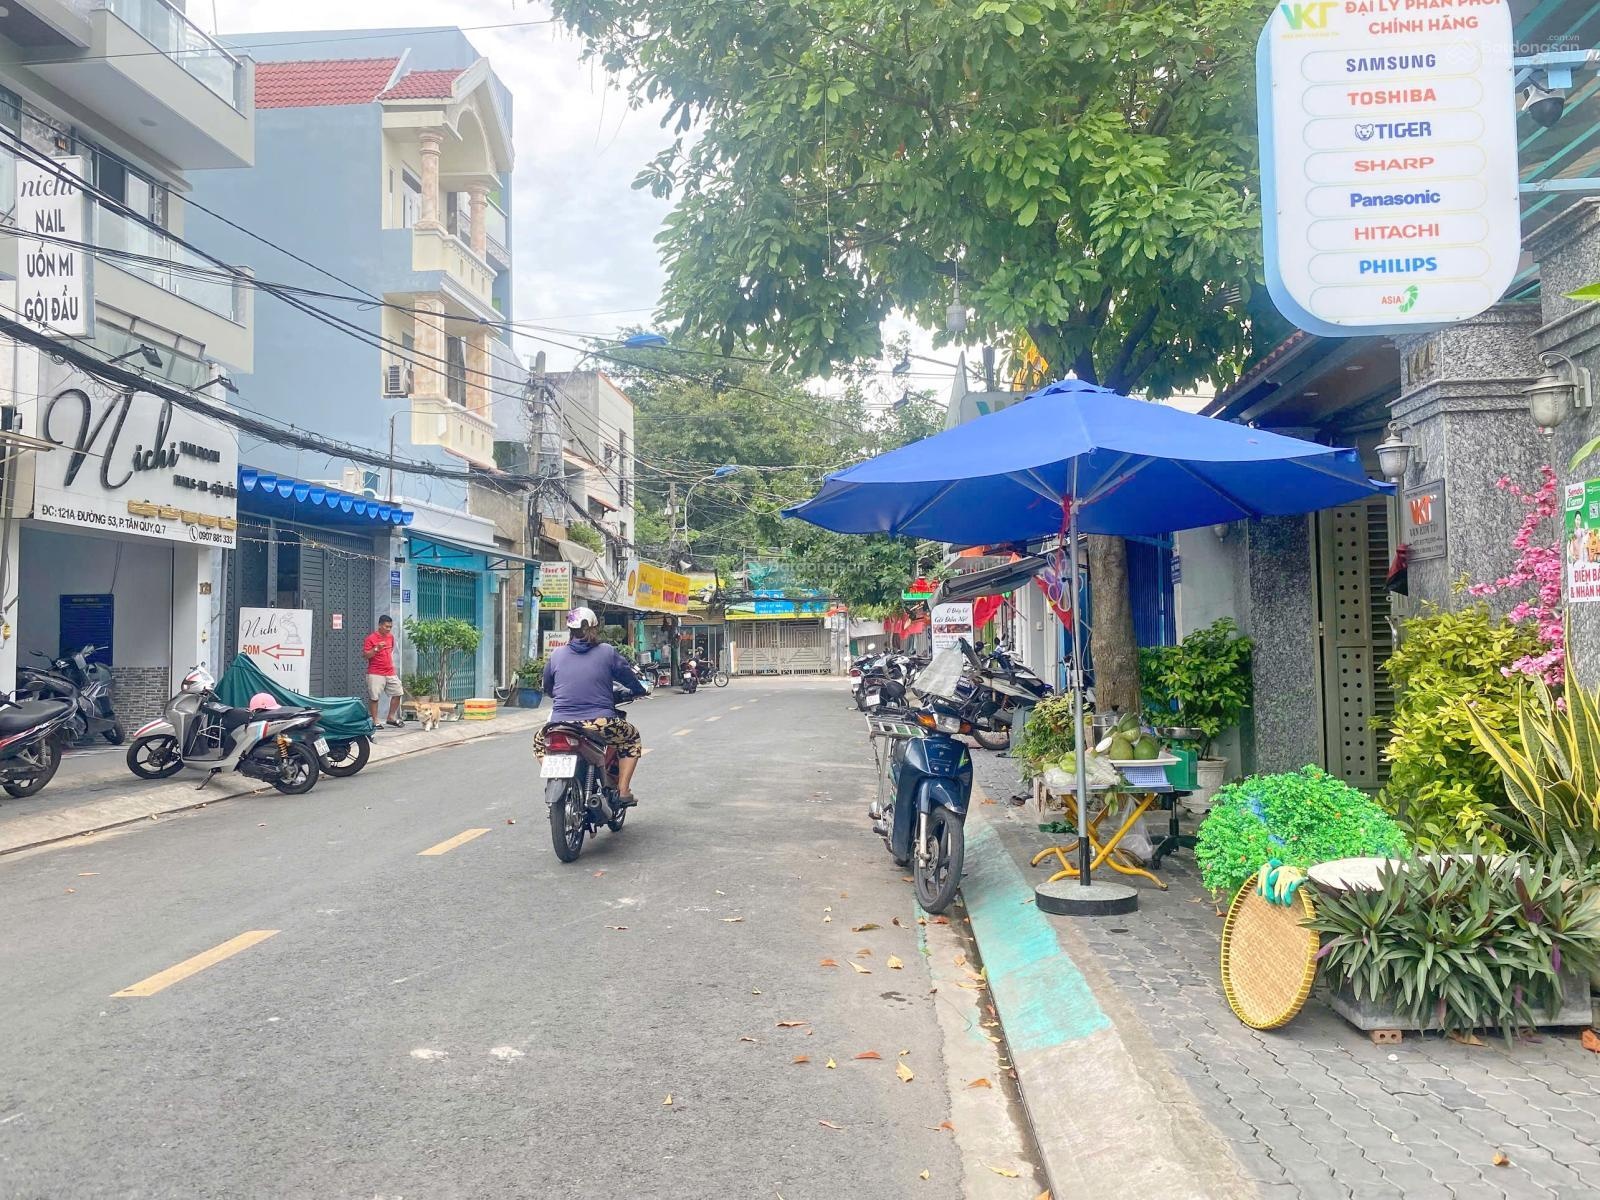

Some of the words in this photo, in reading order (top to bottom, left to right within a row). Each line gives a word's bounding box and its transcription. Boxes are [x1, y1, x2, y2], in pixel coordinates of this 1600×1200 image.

[1280, 2, 1338, 30] VKT
[1345, 0, 1373, 16] ĐẠI
[1369, 17, 1423, 34] CHÍNH
[1428, 14, 1478, 31] HÃNG
[1346, 54, 1437, 73] SAMSUNG
[1347, 88, 1437, 105] TOSHIBA
[1375, 121, 1432, 139] TIGER
[1354, 158, 1435, 172] SHARP
[1350, 190, 1441, 207] Panasonic
[35, 209, 65, 233] NAIL
[1354, 223, 1440, 240] HITACHI
[58, 253, 73, 276] MI
[1359, 257, 1437, 274] PHILIPS
[1381, 295, 1402, 305] ASIA
[24, 290, 48, 329] GỘI
[43, 388, 180, 490] Nichi
[77, 509, 106, 525] ĐƯỜNG
[107, 515, 118, 528] 53,
[126, 517, 139, 530] TÂN
[198, 531, 212, 541] 0907
[223, 535, 233, 545] 333
[1574, 565, 1591, 583] ĐIỂM
[1570, 587, 1575, 598] &
[1576, 583, 1595, 601] NHẬN
[241, 613, 278, 638] Nichi
[242, 644, 260, 655] 50M
